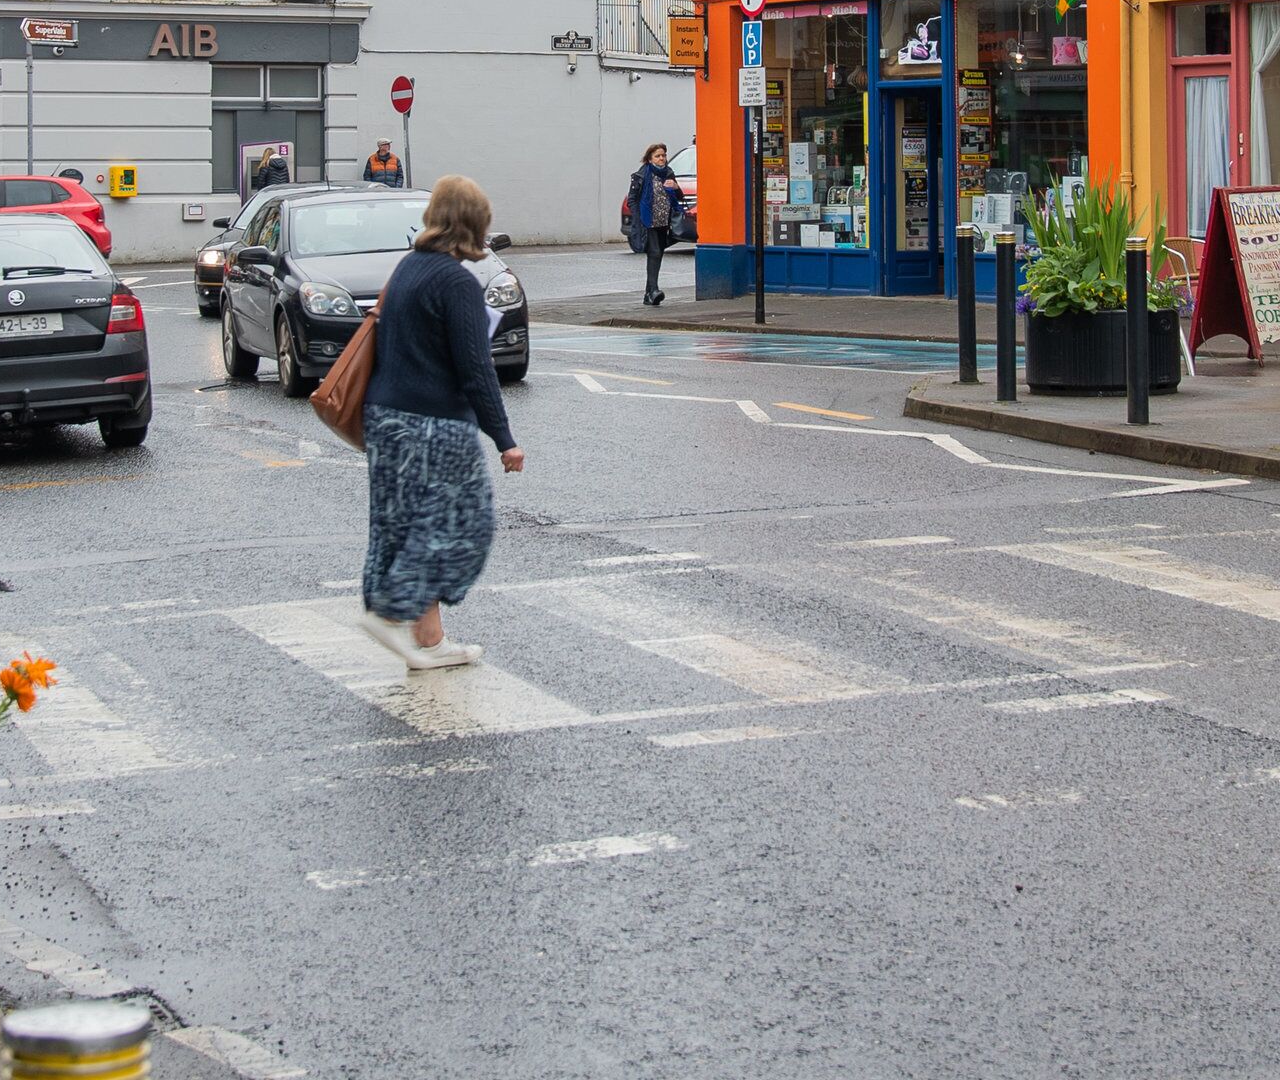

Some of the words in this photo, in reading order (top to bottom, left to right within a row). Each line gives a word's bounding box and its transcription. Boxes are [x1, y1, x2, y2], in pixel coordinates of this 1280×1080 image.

[831, 5, 859, 16] Miele
[35, 25, 67, 35] SuperValu
[148, 24, 219, 58] AIB
[681, 38, 695, 46] Key
[676, 50, 700, 58] Cutting
[748, 50, 756, 65] P
[782, 205, 811, 213] magimix
